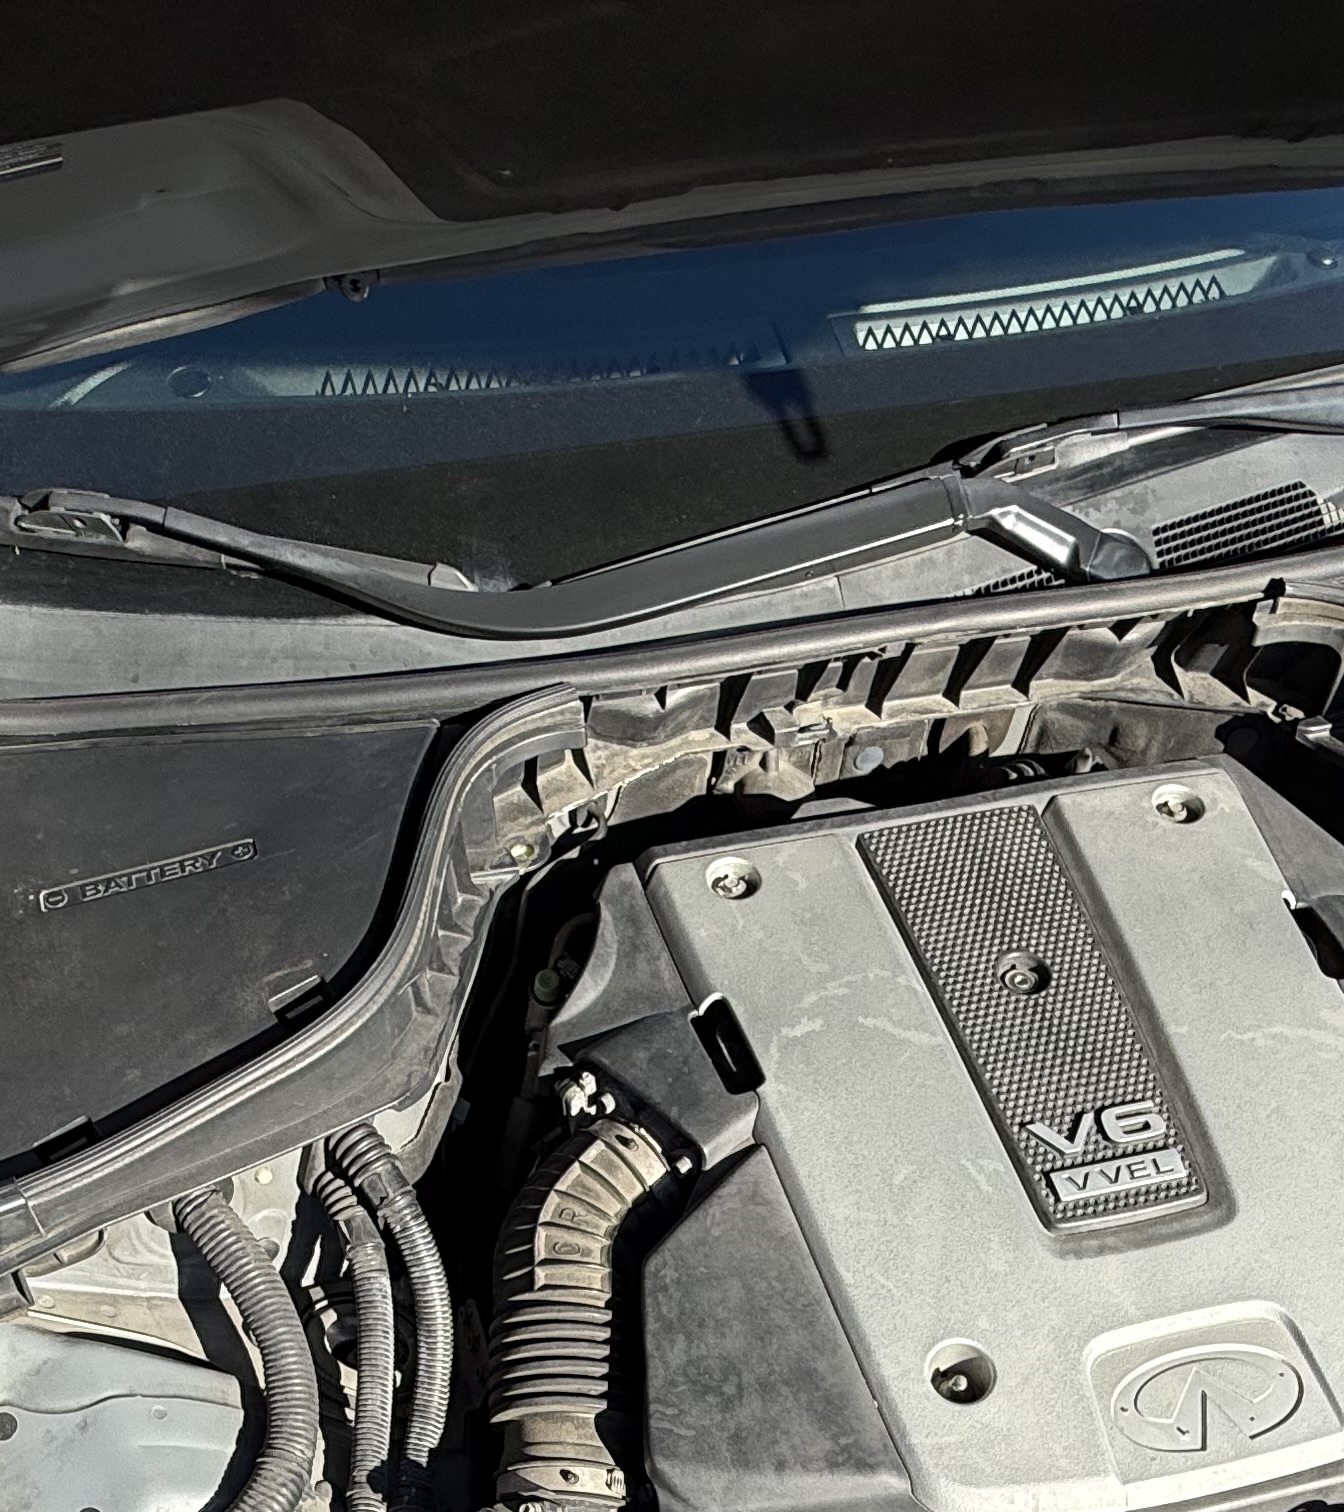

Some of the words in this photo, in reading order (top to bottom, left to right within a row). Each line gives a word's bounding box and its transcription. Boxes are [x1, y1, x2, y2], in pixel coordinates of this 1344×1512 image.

[80, 851, 222, 902] BATTERY
[1024, 1099, 1167, 1155] V6
[1061, 1156, 1175, 1191] VVEL
